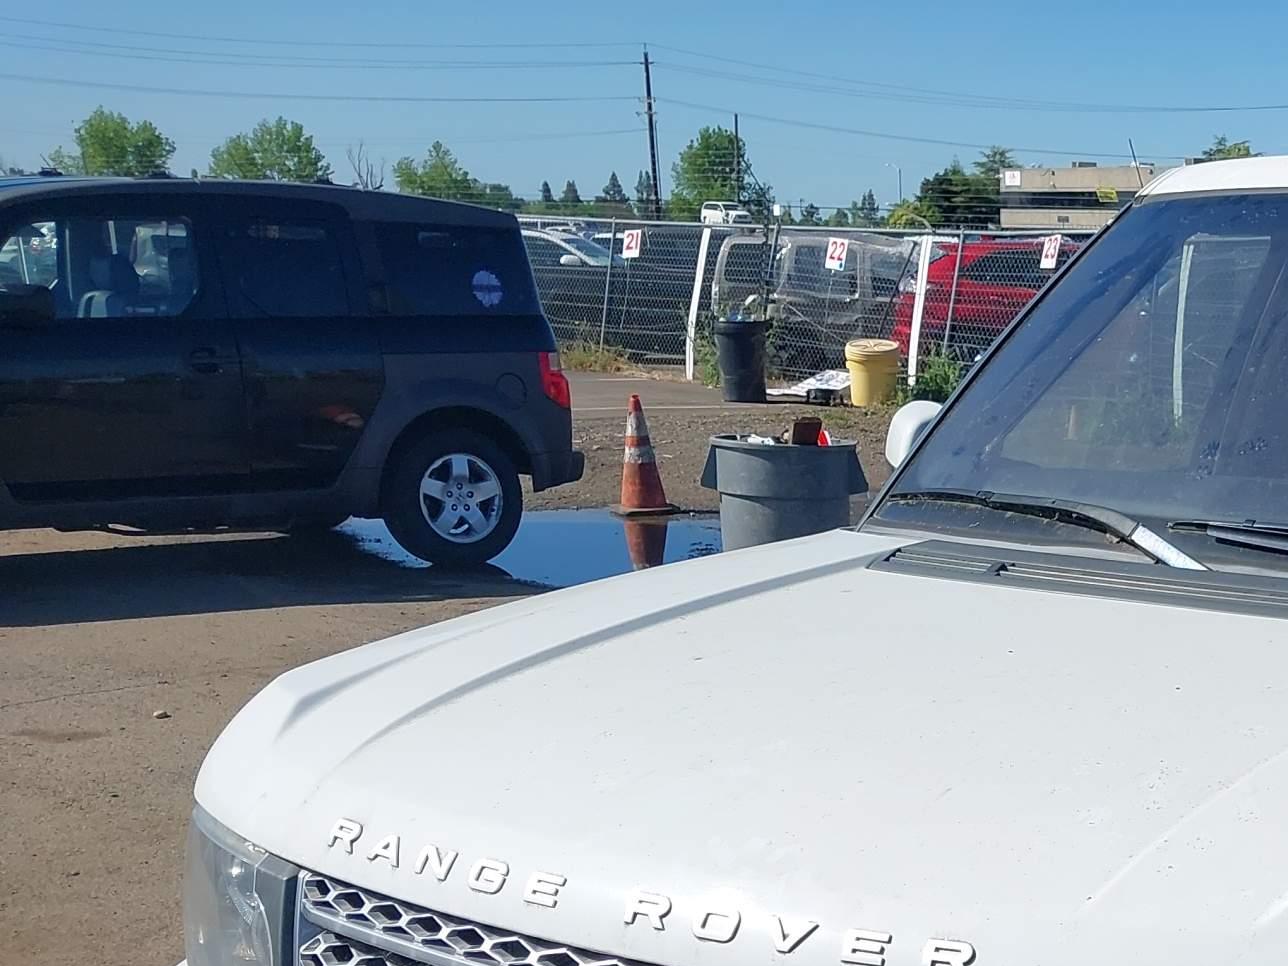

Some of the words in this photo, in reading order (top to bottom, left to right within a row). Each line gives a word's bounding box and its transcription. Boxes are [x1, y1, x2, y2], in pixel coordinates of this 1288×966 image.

[625, 232, 639, 250] 21
[829, 241, 846, 261] 22
[1044, 237, 1058, 259] 23
[328, 817, 568, 909] RANGE
